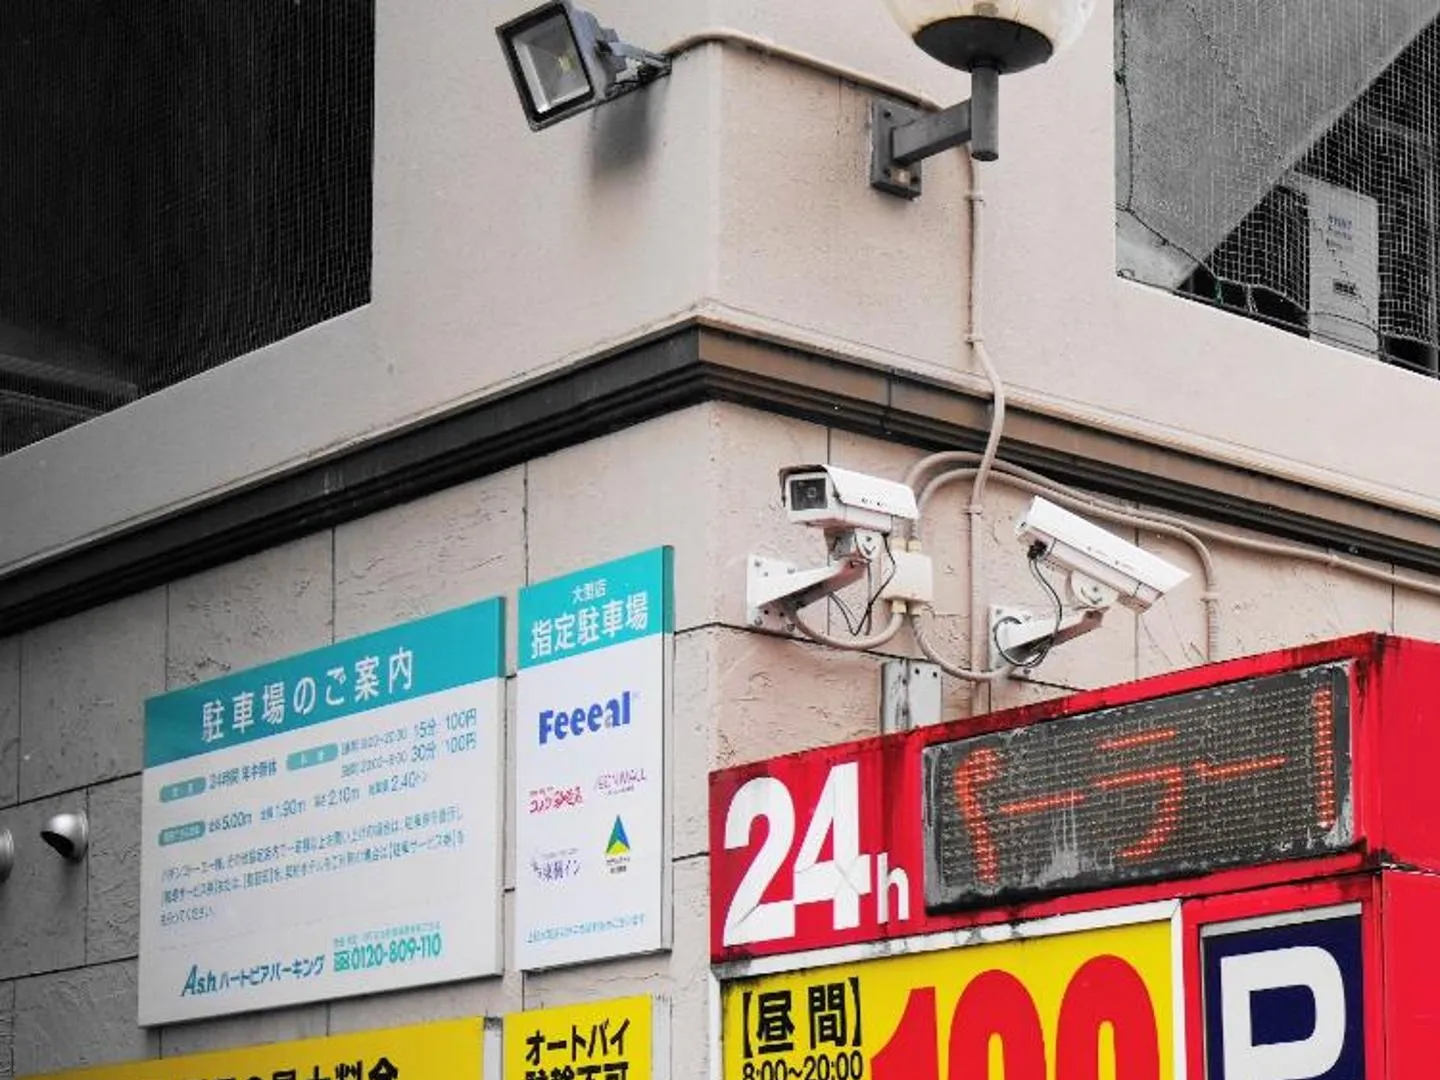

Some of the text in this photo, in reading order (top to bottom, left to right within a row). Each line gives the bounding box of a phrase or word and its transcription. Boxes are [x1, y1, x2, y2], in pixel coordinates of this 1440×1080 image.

[531, 592, 648, 659] 指定駐車場
[201, 646, 413, 743] 駐車場のご案内
[538, 691, 631, 746] Feeeal
[722, 761, 909, 947] 24h
[181, 954, 325, 997] Ash ハートピアパーキング
[351, 932, 443, 971] 0120-809-110
[525, 1017, 630, 1066] オートバイ
